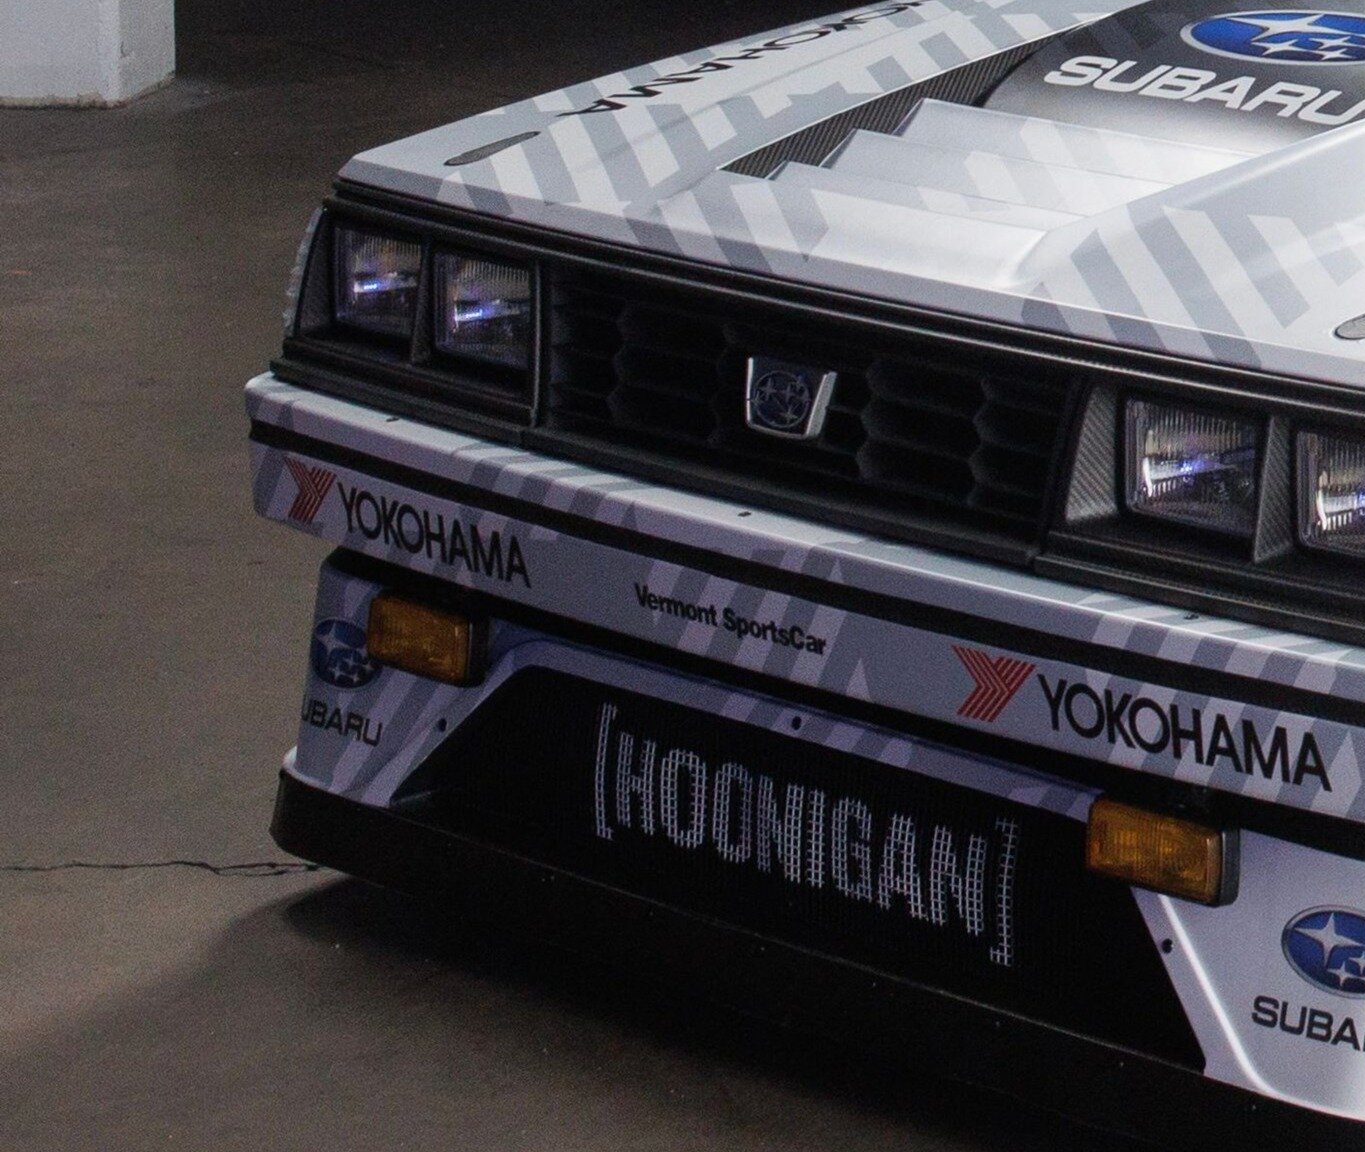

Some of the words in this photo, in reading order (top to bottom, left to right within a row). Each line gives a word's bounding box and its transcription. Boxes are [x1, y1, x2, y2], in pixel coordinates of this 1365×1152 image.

[336, 482, 531, 588] YOKOHAMA
[633, 582, 717, 628] Vermont
[301, 693, 383, 747] UBARU
[1037, 674, 1333, 792] YOKOHAMA
[595, 702, 1019, 968] [HOONIGAN]
